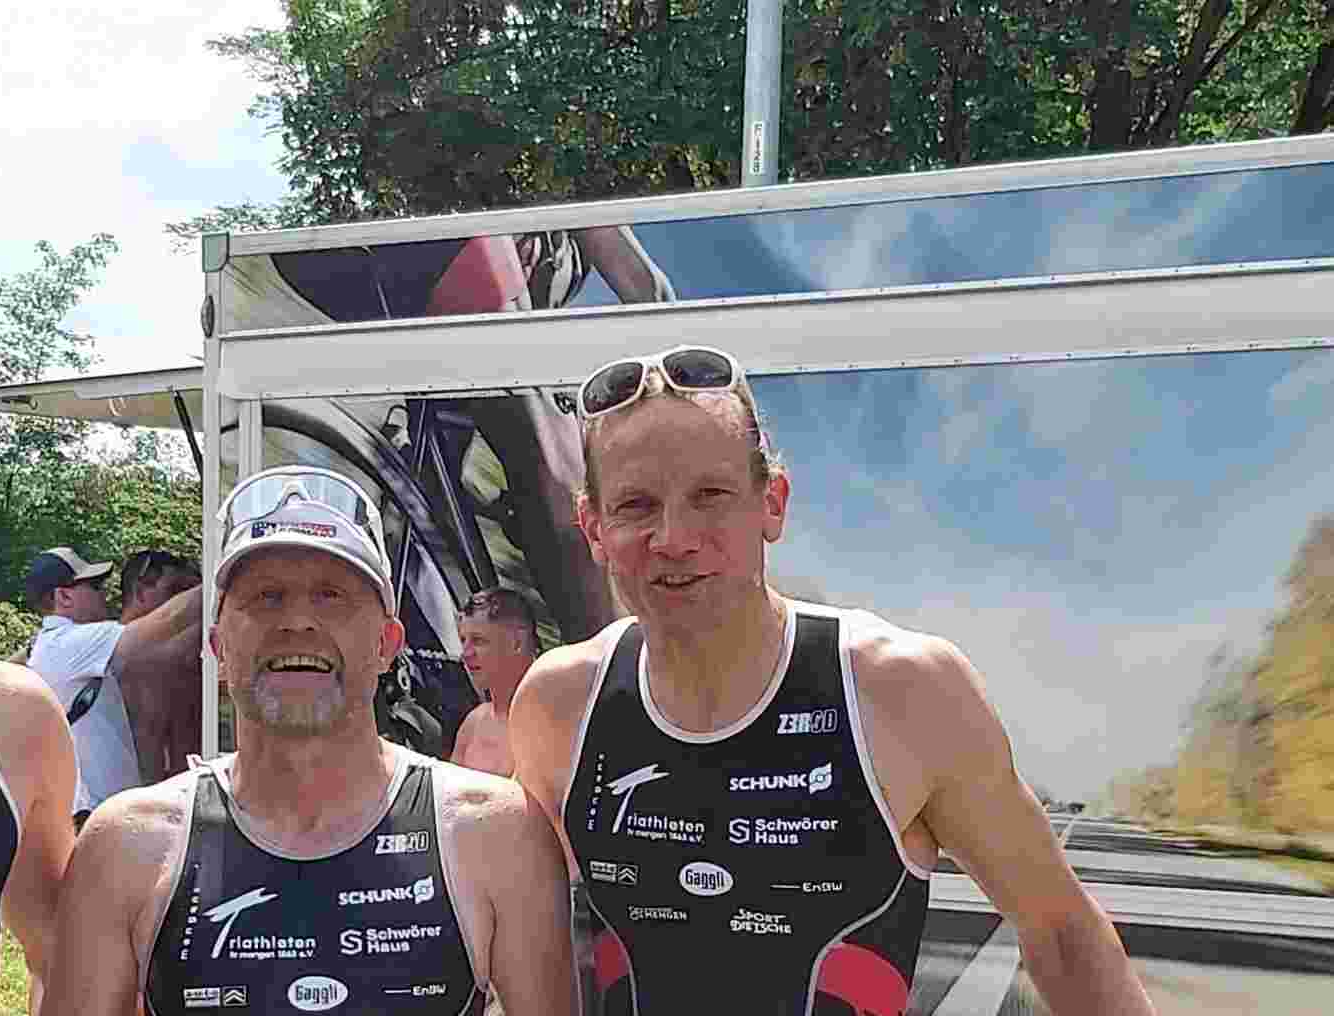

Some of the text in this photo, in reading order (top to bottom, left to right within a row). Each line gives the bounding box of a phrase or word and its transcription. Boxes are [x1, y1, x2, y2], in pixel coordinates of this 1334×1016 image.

[729, 774, 807, 791] SCHUNK
[754, 817, 839, 831] Schwörer
[754, 831, 799, 845] Haus
[339, 887, 413, 906] SCHUNK
[733, 908, 787, 924] SPORT
[366, 925, 442, 941] Schwörer
[367, 940, 411, 954] Haus
[295, 984, 338, 1005] Gaggli
